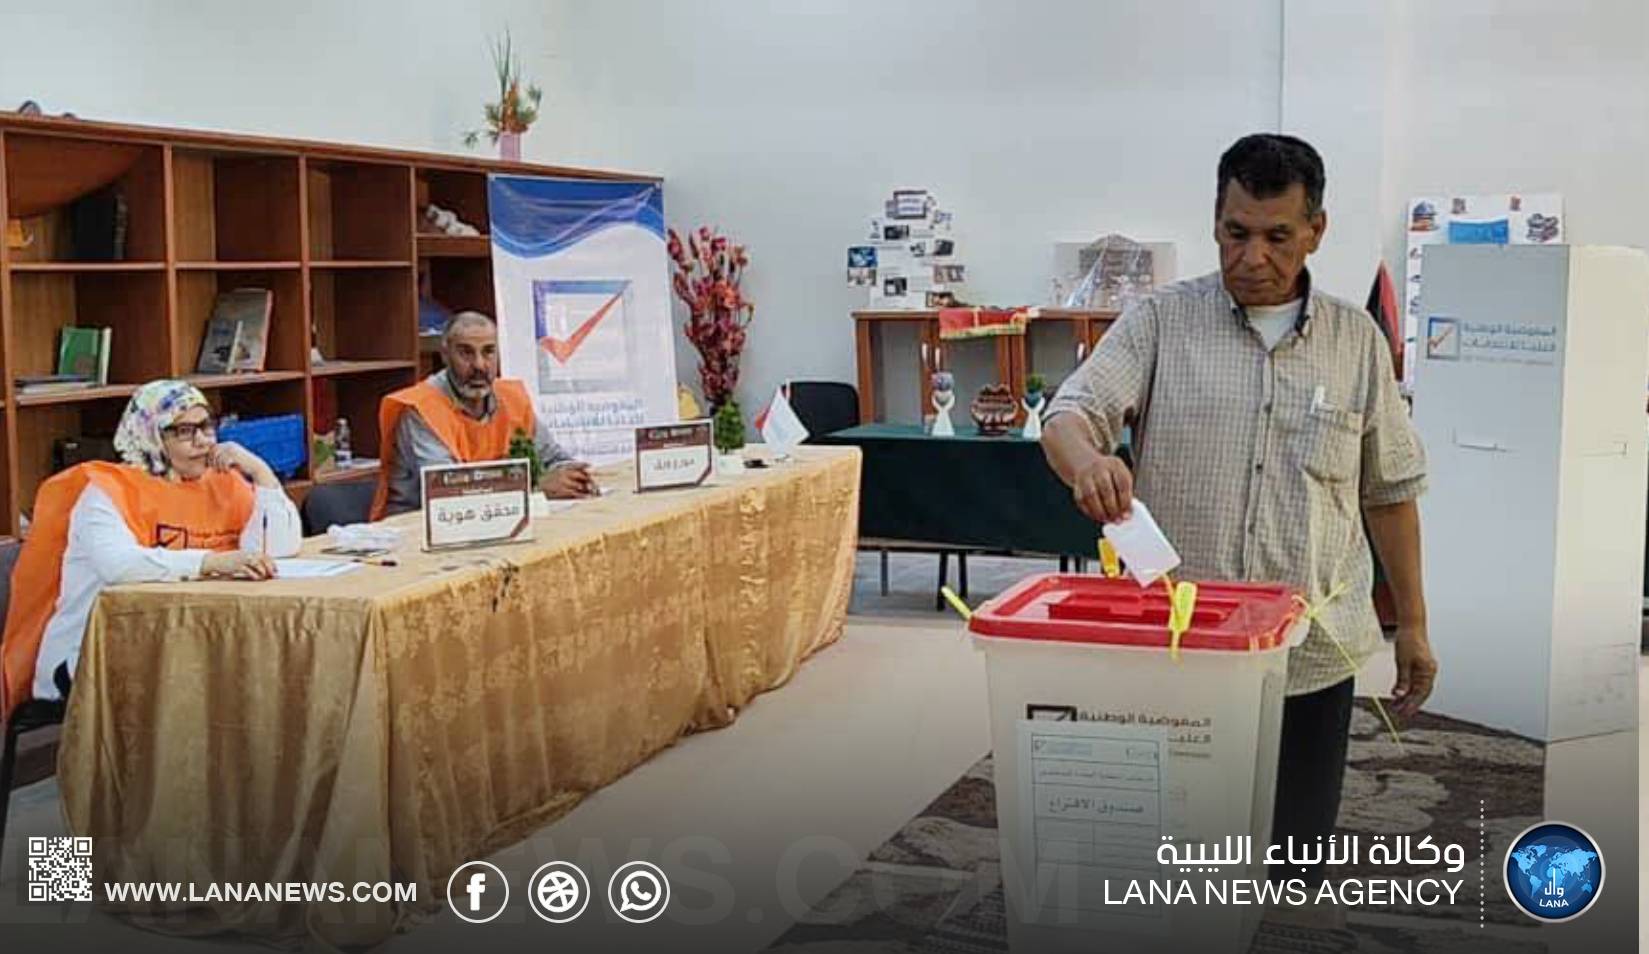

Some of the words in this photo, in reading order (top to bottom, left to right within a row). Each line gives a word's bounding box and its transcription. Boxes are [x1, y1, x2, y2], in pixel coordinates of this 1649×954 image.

[437, 507, 476, 525] هوية
[1079, 711, 1135, 725] الوطنية
[1138, 712, 1211, 728] المفوضية
